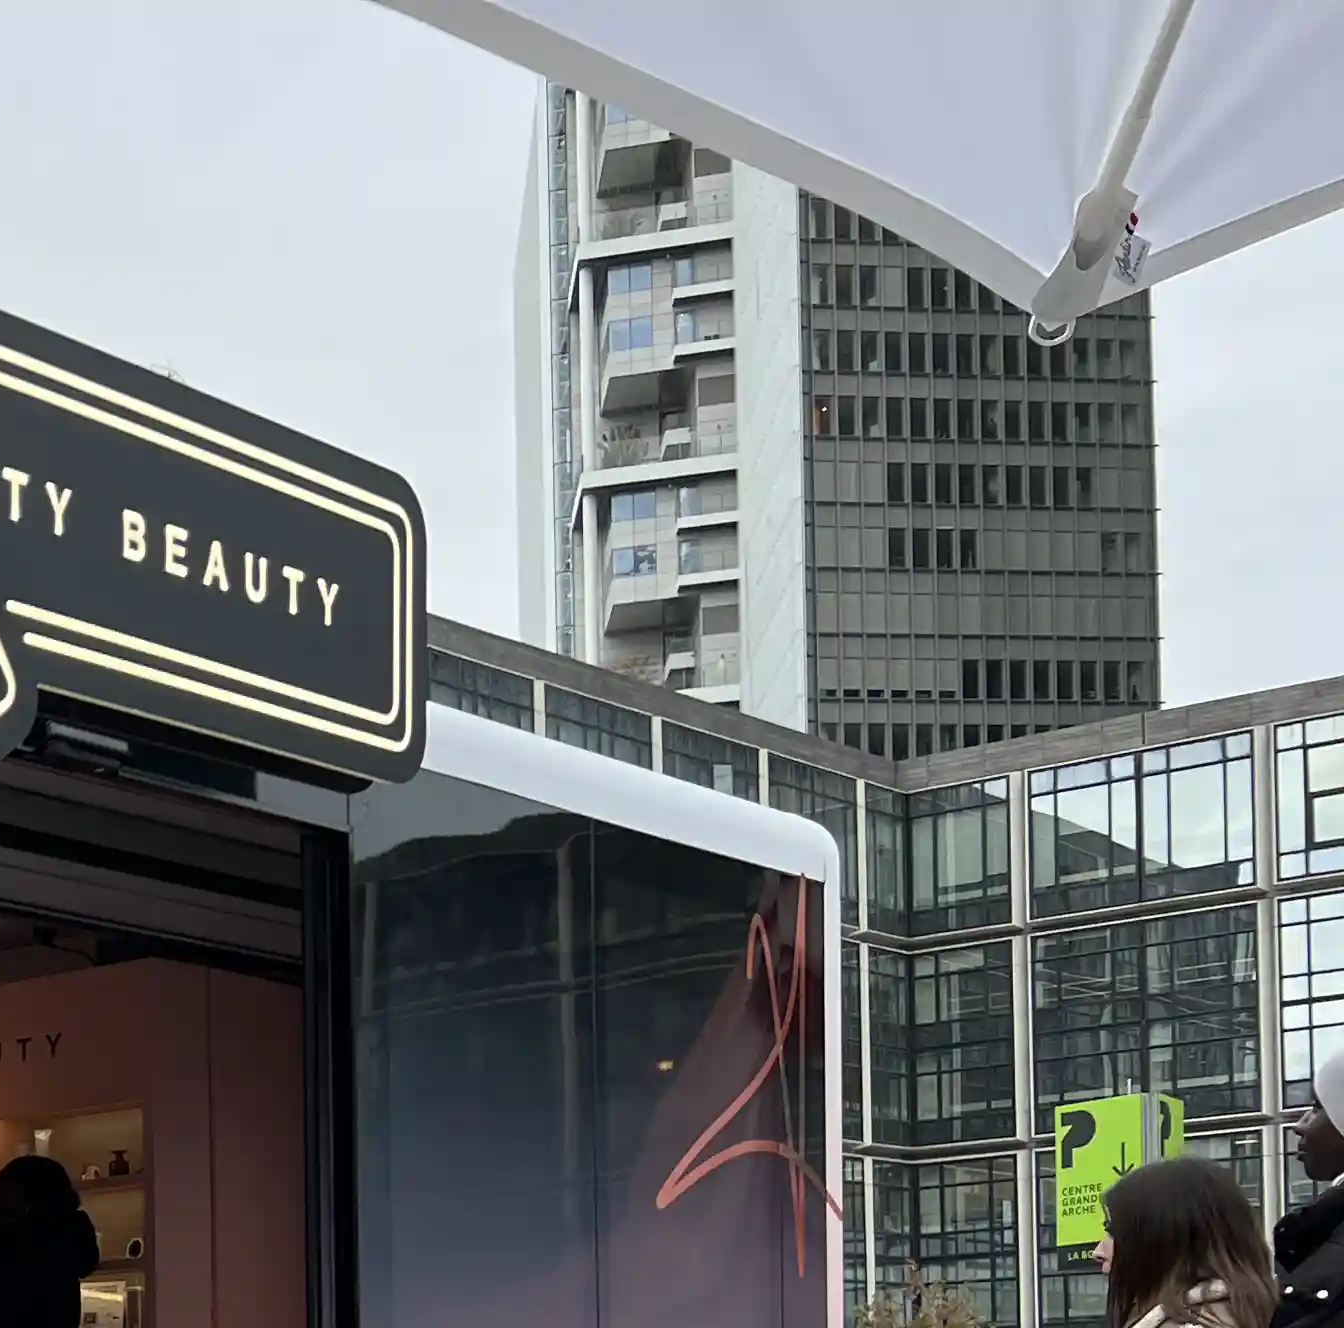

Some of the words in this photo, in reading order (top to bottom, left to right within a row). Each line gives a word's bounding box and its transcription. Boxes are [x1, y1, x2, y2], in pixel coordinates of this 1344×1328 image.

[120, 506, 340, 627] BEAUTY
[1061, 1182, 1103, 1197] CENTRE
[1061, 1205, 1097, 1217] ARCHE
